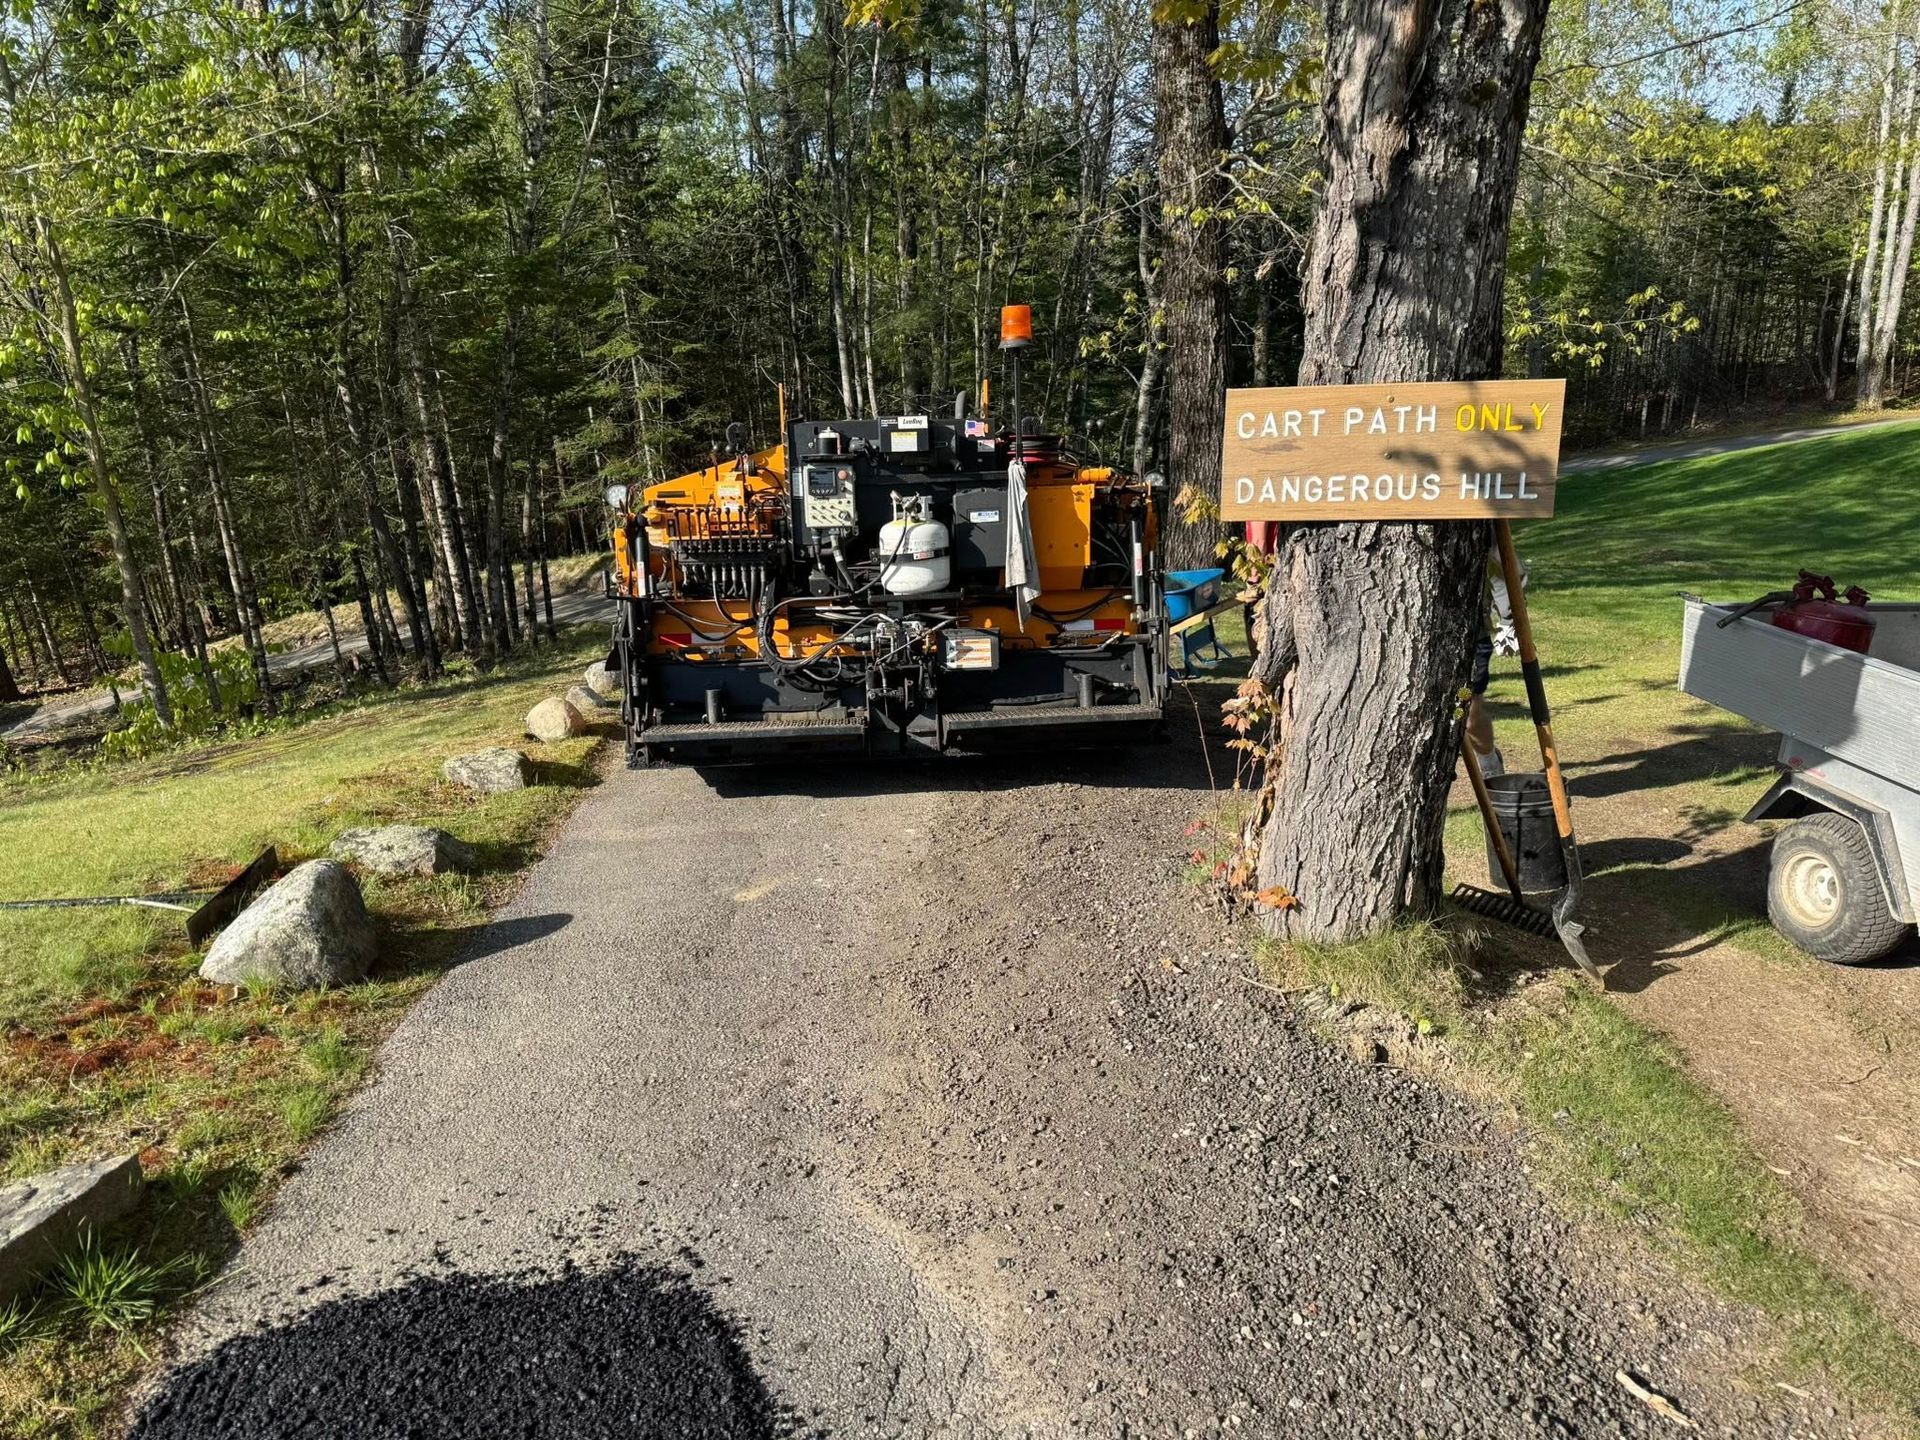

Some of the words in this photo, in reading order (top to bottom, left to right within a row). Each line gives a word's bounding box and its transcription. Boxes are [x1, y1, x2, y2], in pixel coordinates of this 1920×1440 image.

[1238, 408, 1326, 439] CART
[1343, 404, 1437, 436] PATH
[1455, 401, 1551, 432] ONLY
[1236, 472, 1441, 504] DANGEROUS
[1458, 471, 1539, 500] HILL
